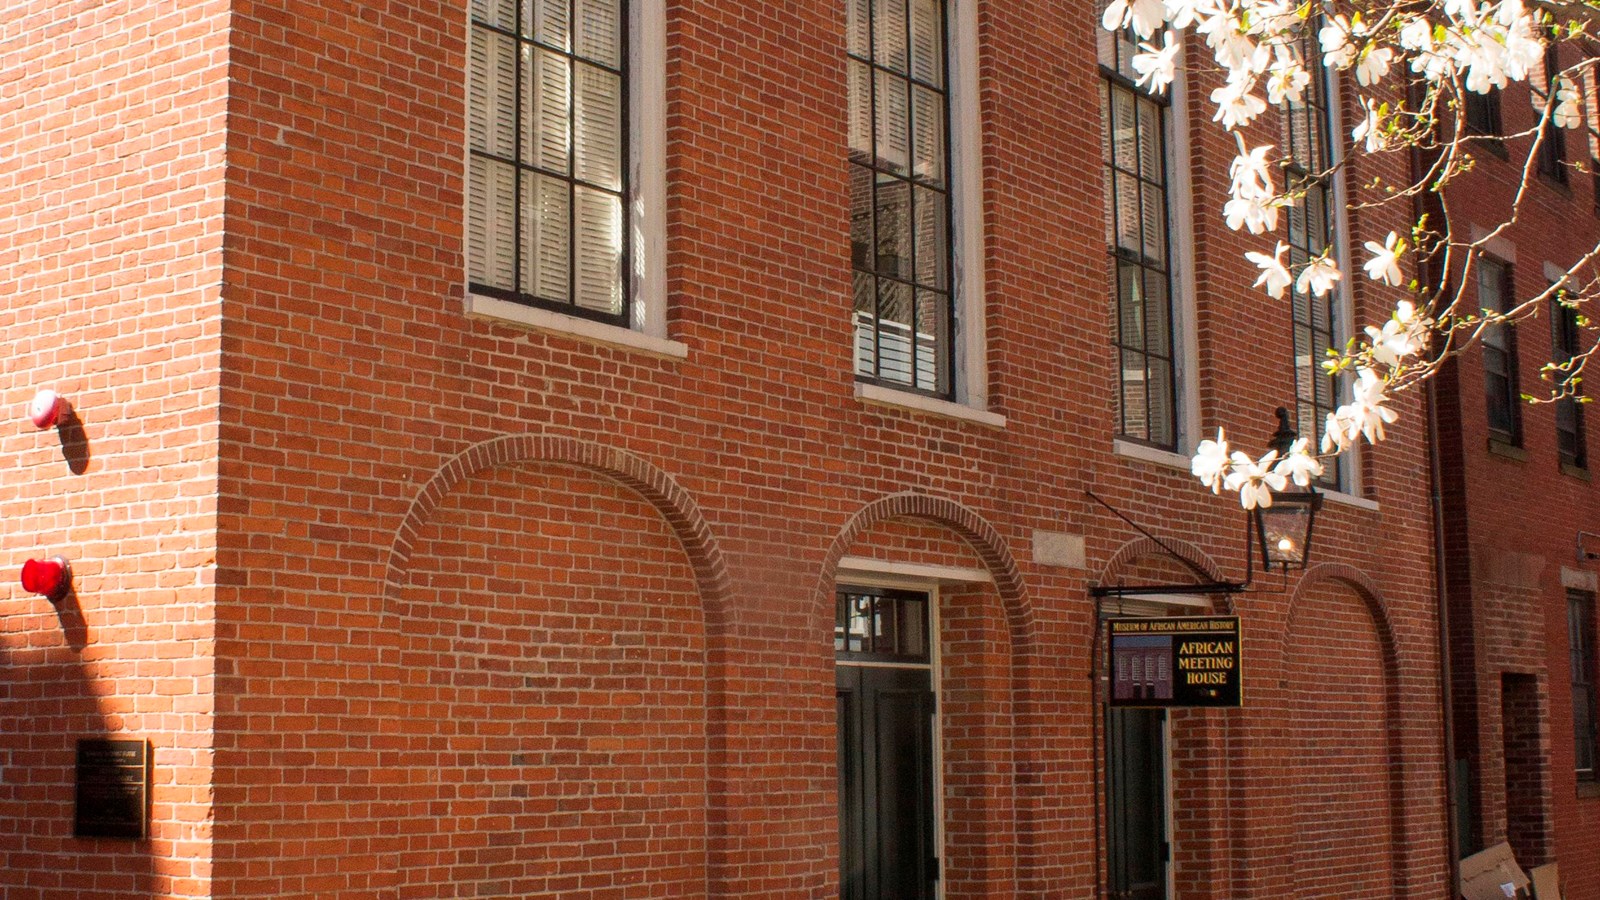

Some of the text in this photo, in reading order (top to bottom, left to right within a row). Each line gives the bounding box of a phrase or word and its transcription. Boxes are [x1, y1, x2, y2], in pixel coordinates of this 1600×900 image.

[1113, 620, 1234, 631] MUSEUM OF AFRICAN AMERICAN HISTORY
[1179, 642, 1233, 655] AFRICAN
[1179, 657, 1233, 670] MEETING
[1187, 672, 1227, 684] HOUSE
